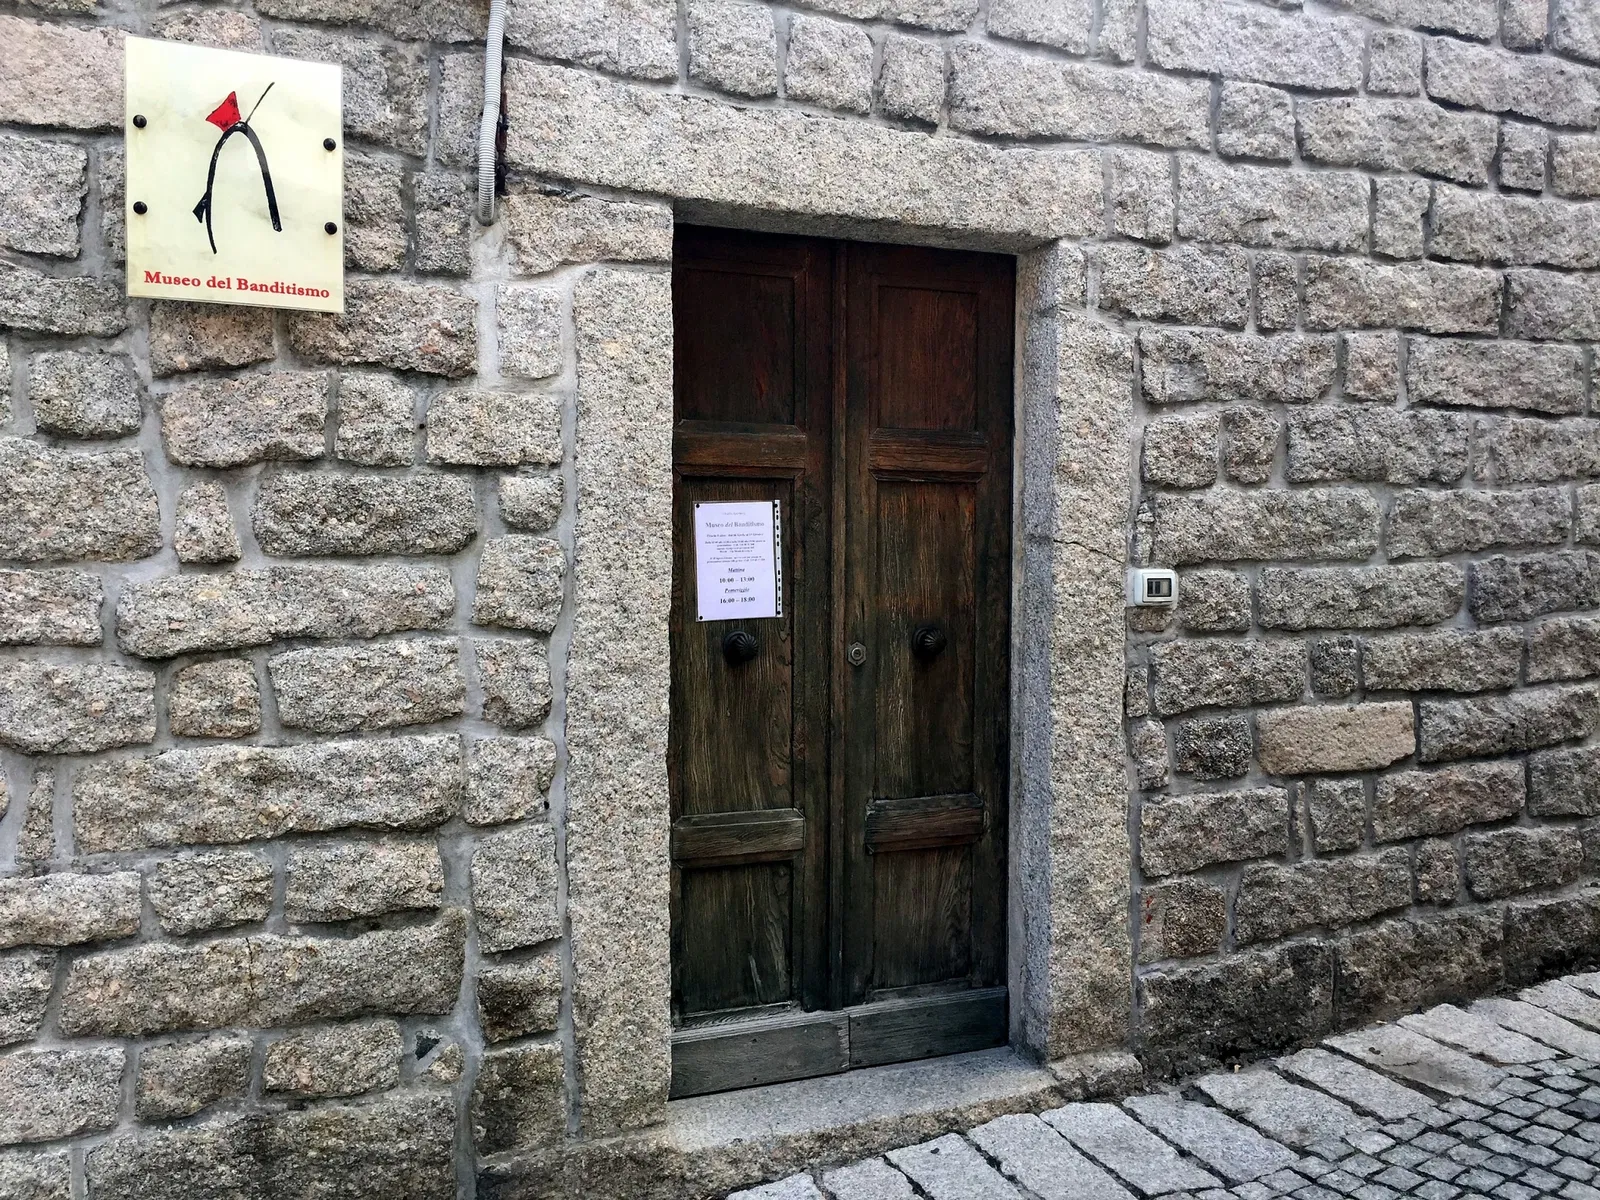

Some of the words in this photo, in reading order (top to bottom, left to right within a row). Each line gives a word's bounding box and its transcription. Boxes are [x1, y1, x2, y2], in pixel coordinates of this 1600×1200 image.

[144, 270, 201, 287] Museo
[206, 276, 231, 290] del
[236, 278, 330, 298] Banditismo
